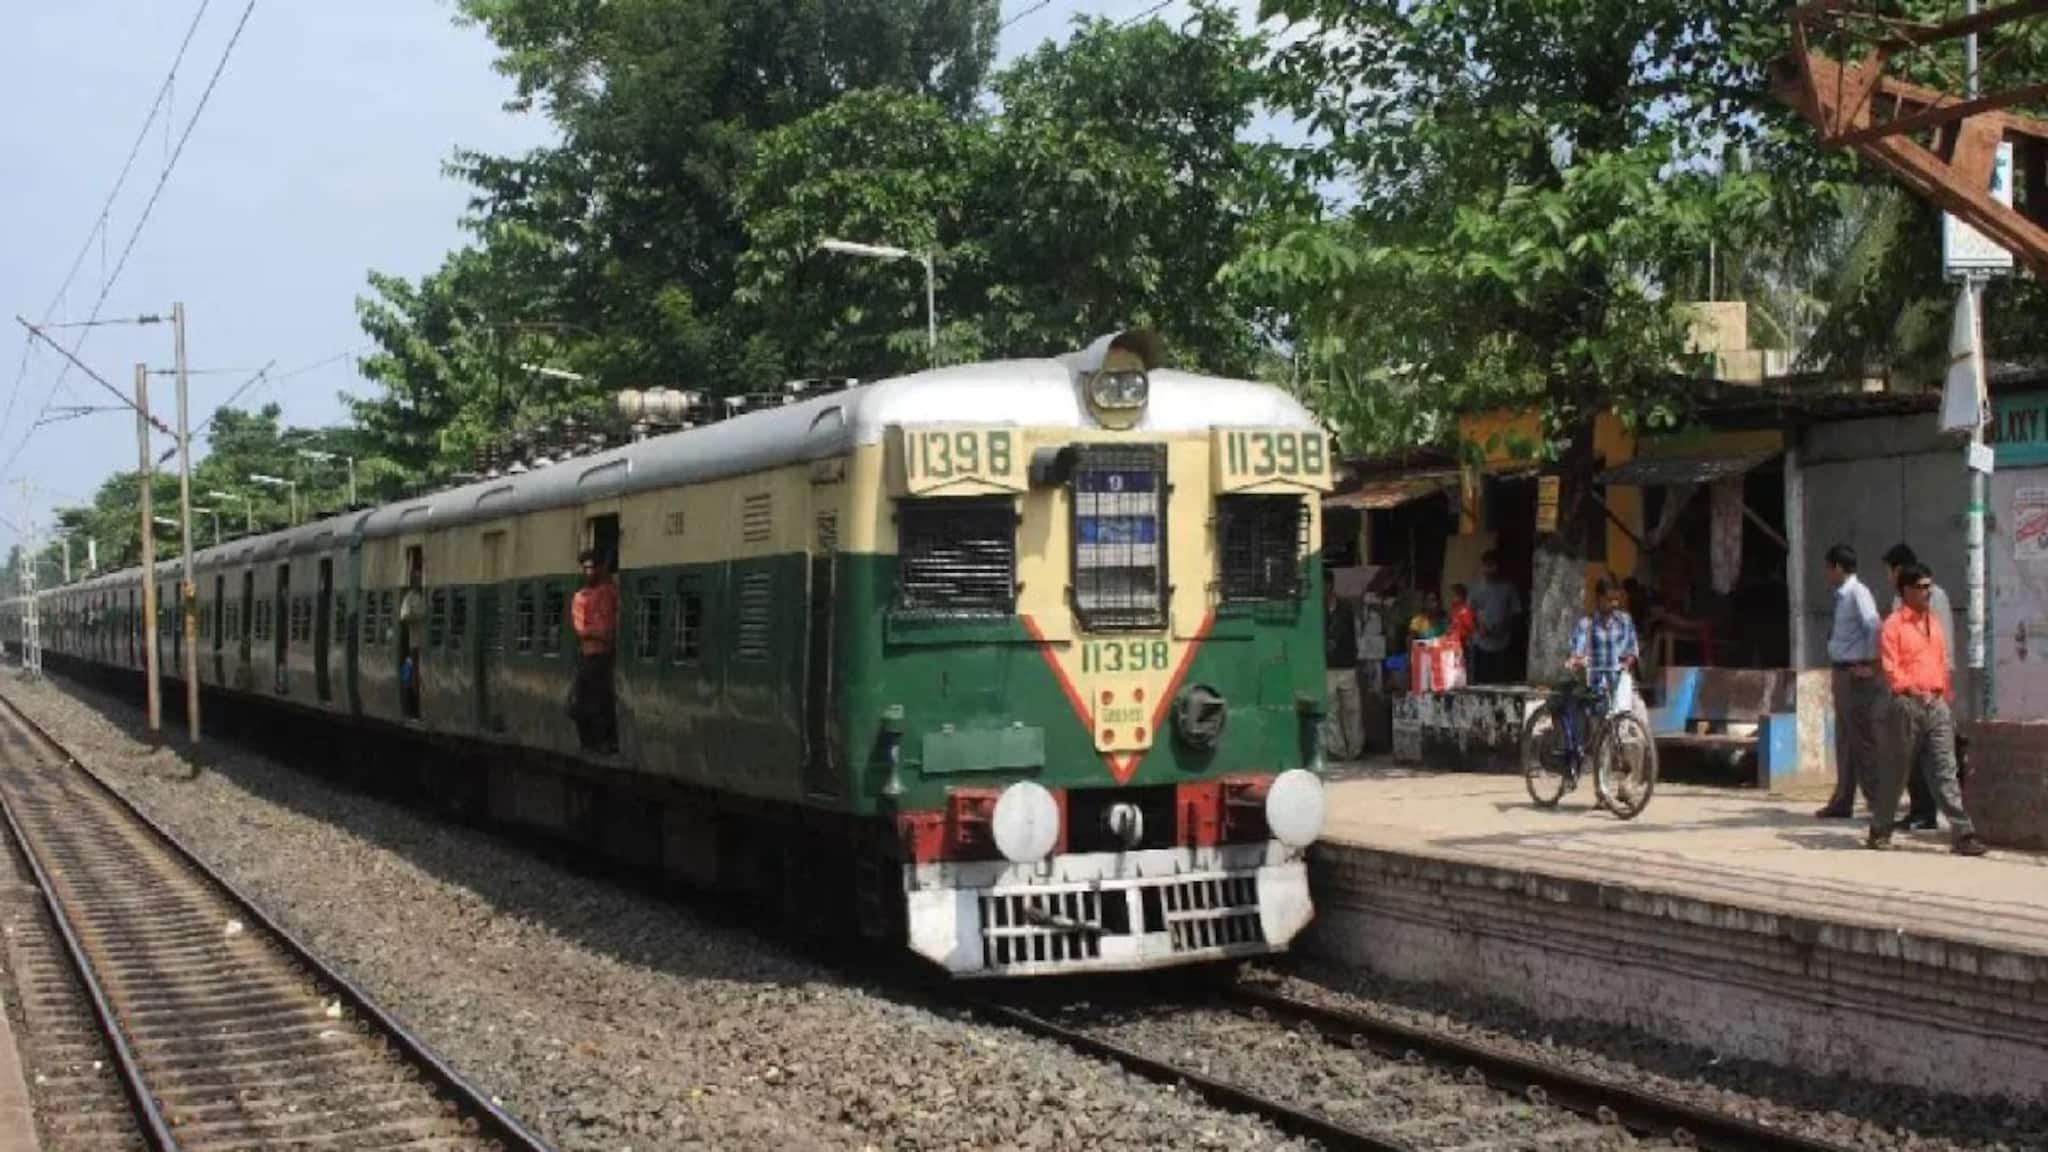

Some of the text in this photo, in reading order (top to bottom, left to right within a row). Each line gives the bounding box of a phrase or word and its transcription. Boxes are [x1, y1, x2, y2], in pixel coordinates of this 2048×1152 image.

[909, 430, 1010, 479] 11398
[1227, 431, 1323, 476] 11398
[1082, 640, 1169, 674] 11398
